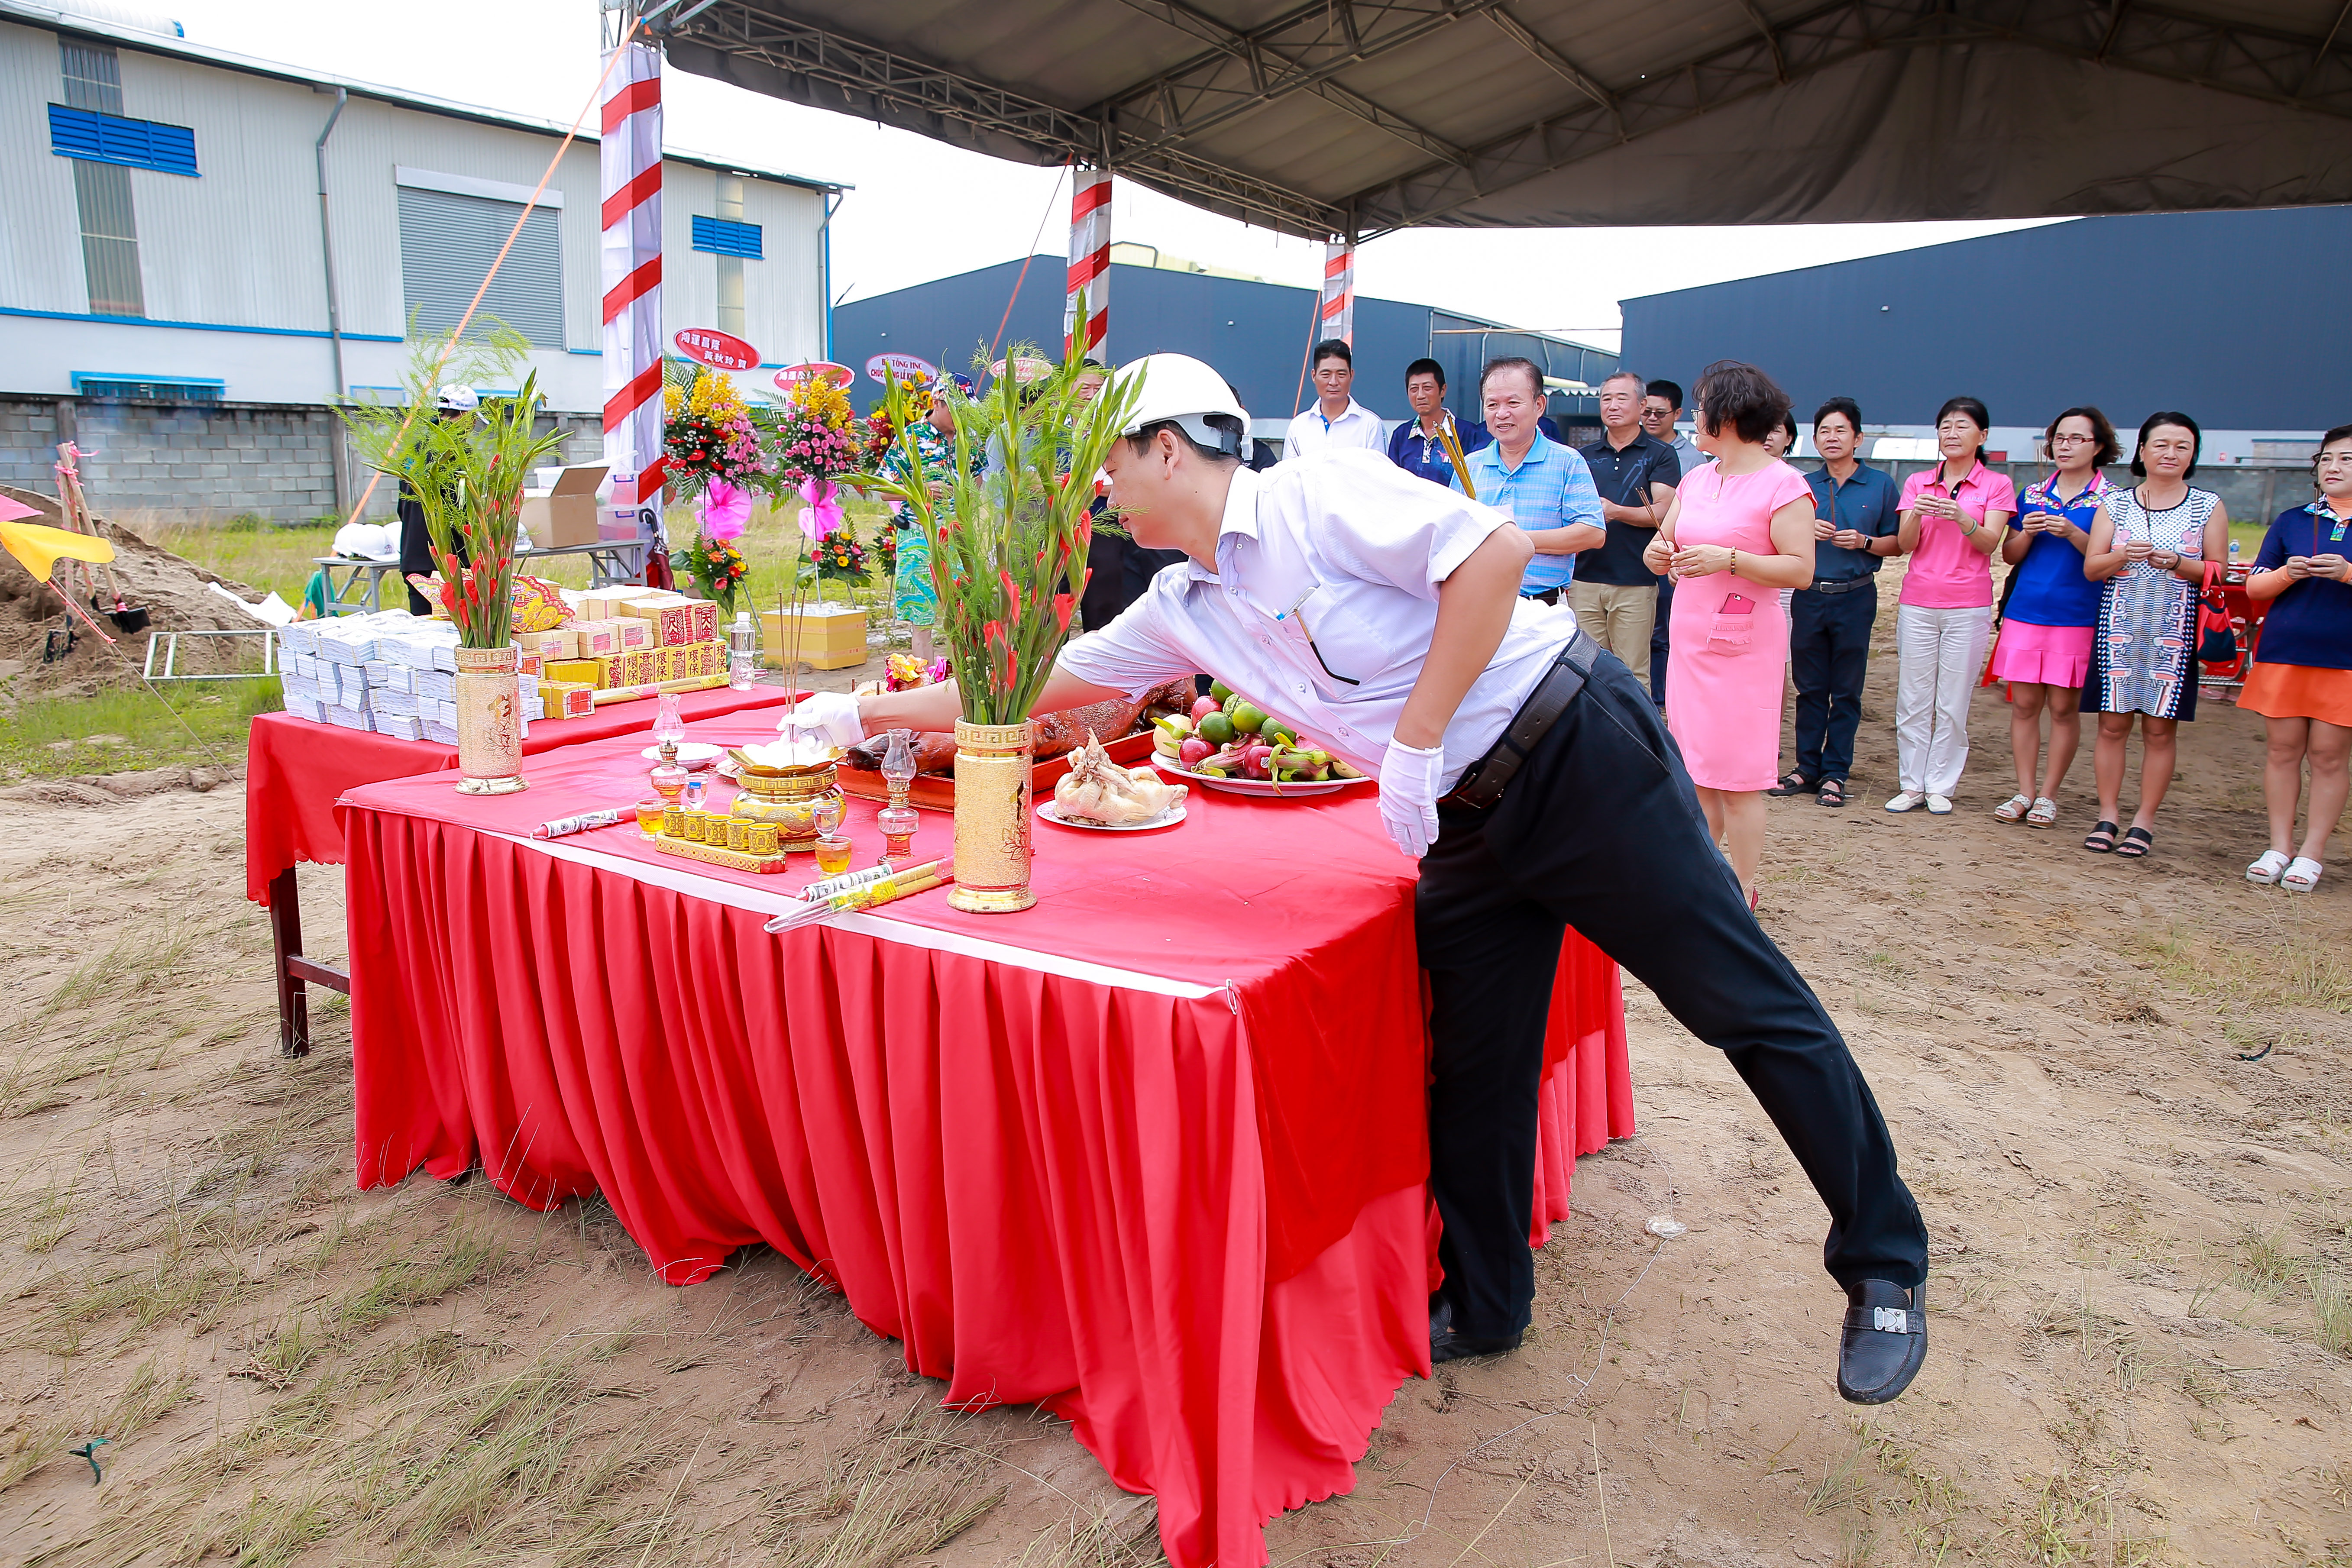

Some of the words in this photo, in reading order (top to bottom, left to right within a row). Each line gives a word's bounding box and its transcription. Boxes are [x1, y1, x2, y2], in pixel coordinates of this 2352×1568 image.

[627, 656, 637, 686] 環保
[656, 651, 667, 682] 環保
[689, 649, 699, 676] 環保
[716, 645, 726, 674] 環保
